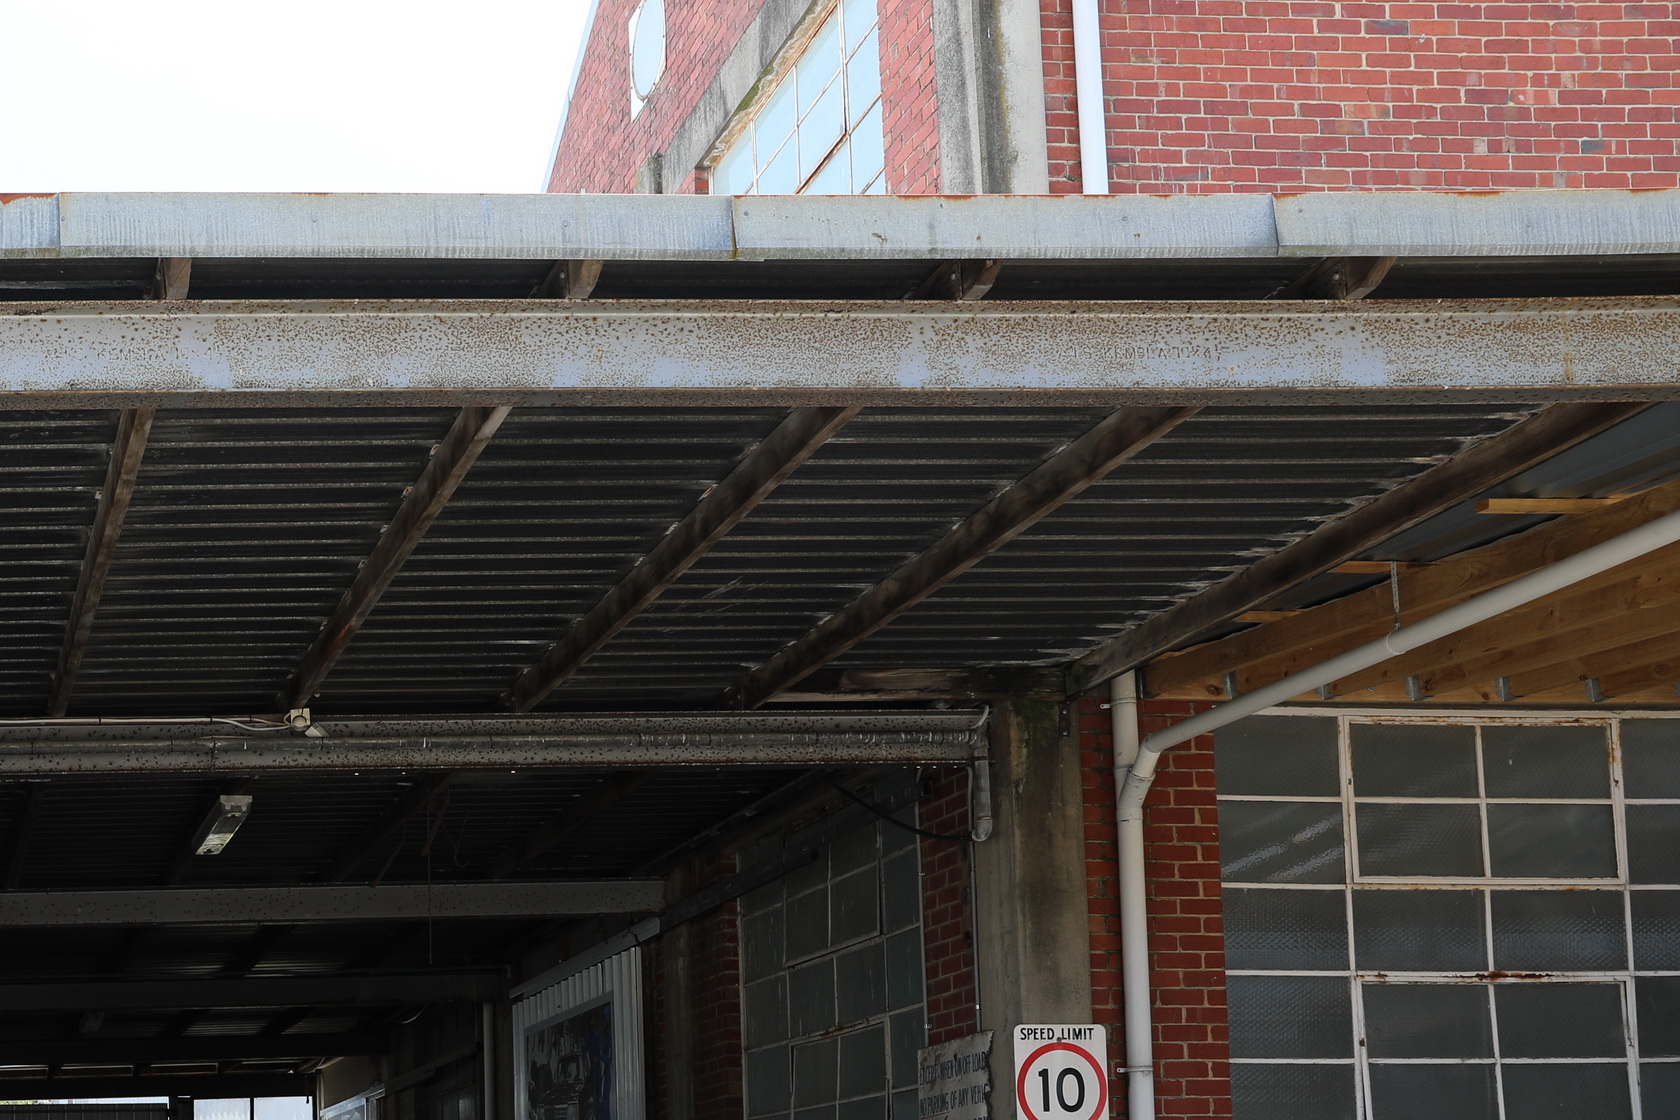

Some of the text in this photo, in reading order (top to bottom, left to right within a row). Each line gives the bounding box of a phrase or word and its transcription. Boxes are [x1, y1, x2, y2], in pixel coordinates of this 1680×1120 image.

[1020, 1027, 1095, 1041] SPEED LIMIT
[1037, 1067, 1086, 1113] 10
